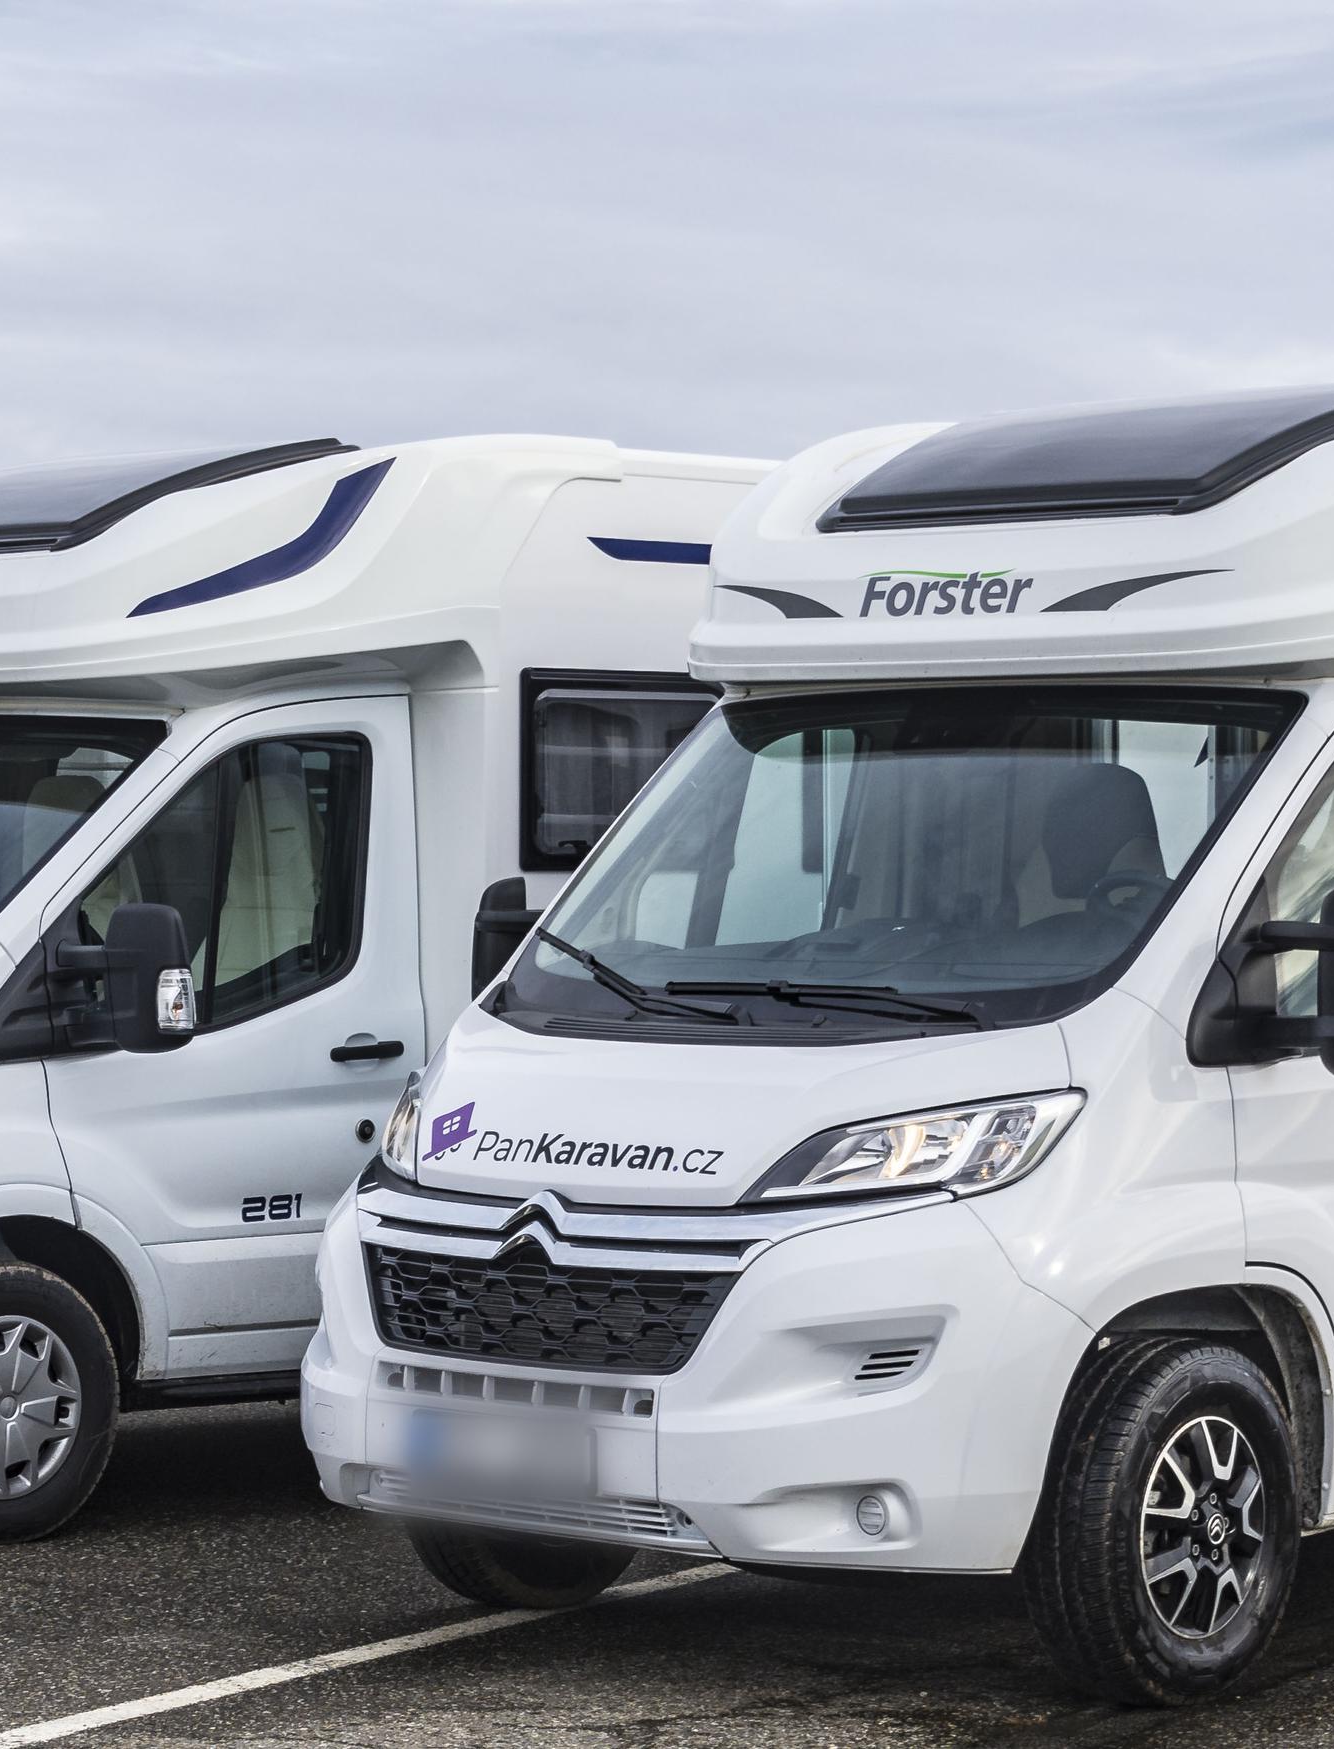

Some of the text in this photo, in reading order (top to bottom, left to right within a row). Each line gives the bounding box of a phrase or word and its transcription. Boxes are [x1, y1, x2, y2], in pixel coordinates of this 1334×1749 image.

[859, 571, 1034, 618] Forster
[472, 1130, 725, 1176] PanKaravan.cz
[241, 1192, 303, 1223] 281
